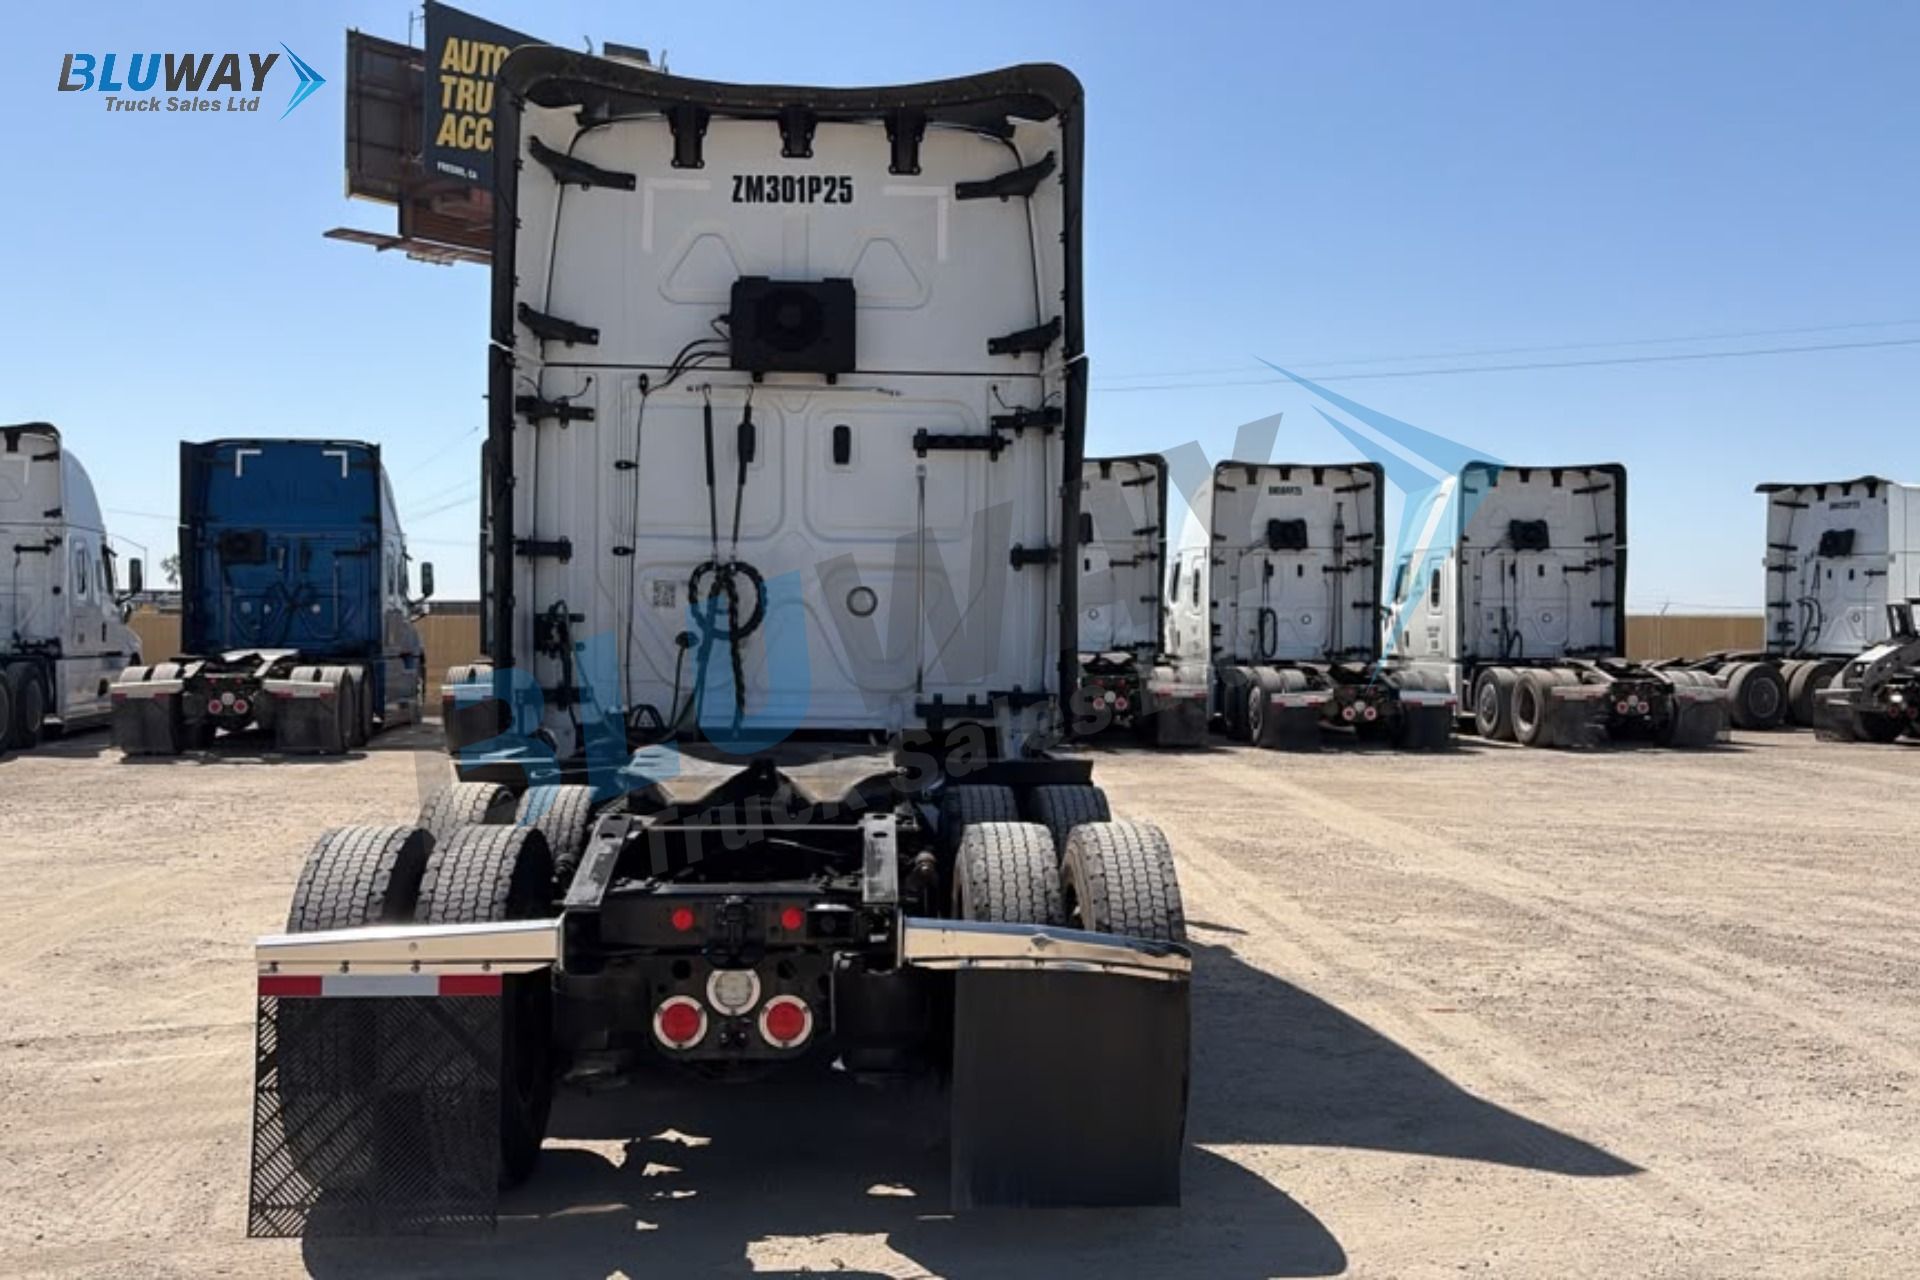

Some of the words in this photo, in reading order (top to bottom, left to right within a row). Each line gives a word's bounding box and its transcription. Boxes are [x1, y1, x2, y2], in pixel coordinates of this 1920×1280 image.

[440, 75, 494, 114] TRU
[436, 113, 494, 152] ACC
[732, 174, 853, 204] ZM301P25
